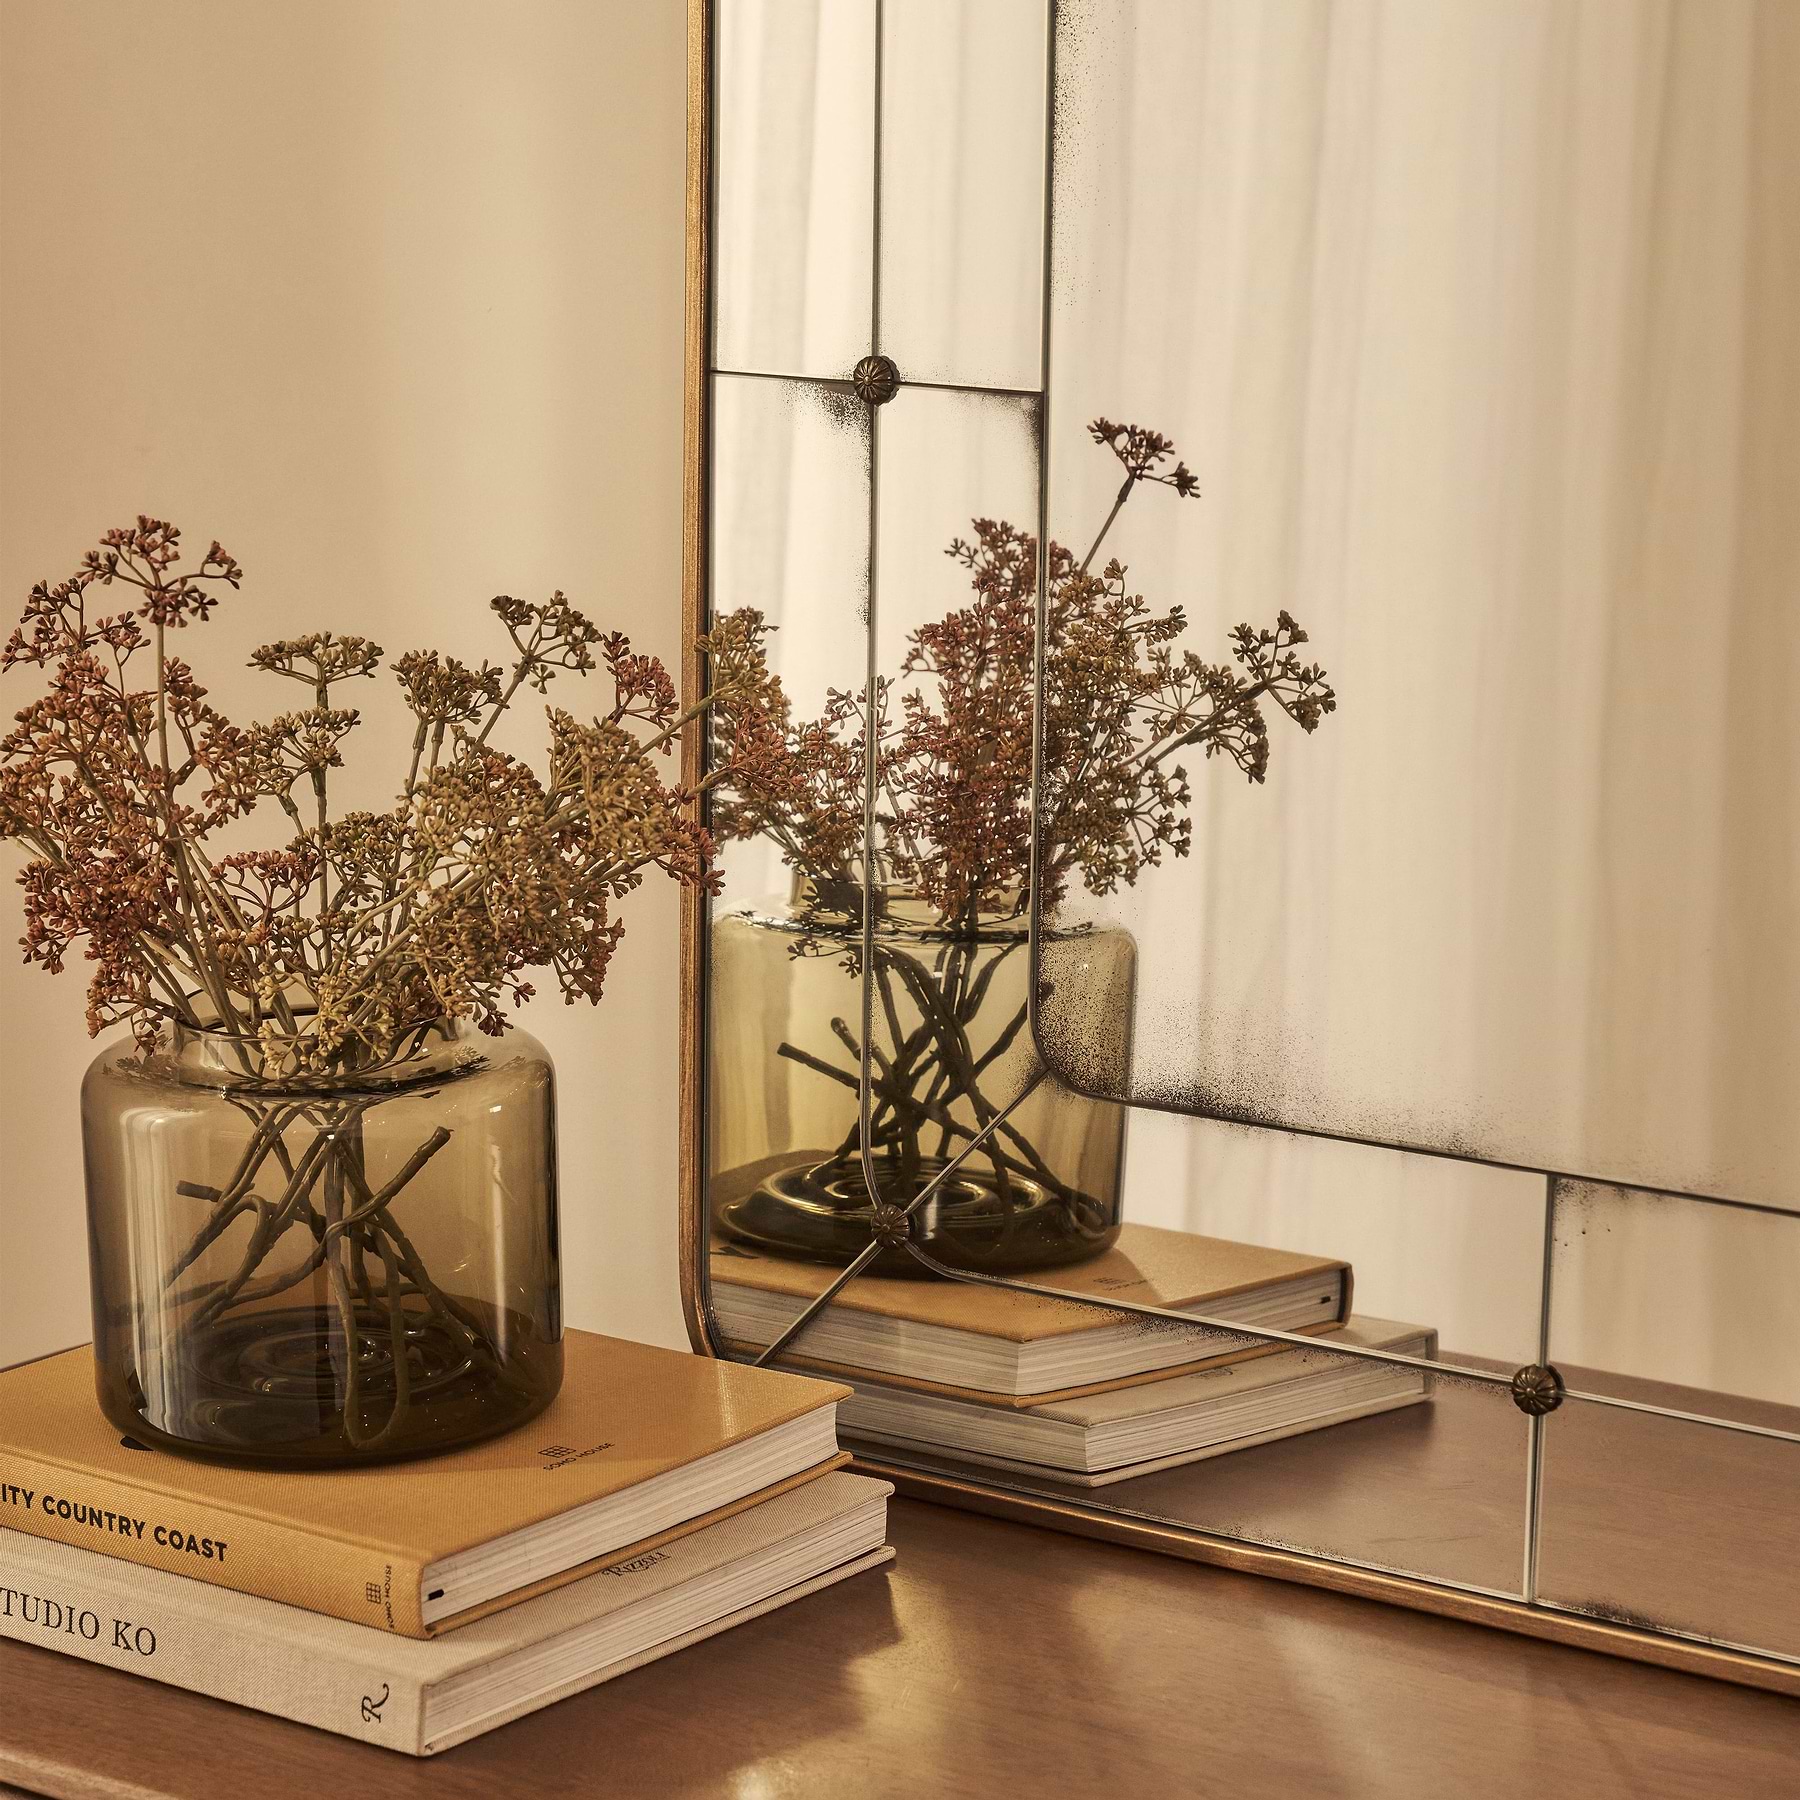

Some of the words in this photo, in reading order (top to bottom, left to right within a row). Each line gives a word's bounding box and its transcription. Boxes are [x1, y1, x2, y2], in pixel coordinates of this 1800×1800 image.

[42, 1495, 146, 1539] COUNTRY
[153, 1525, 228, 1562] COAST
[384, 1564, 392, 1598] HOUSE
[0, 1587, 100, 1641] TUDIO
[111, 1619, 157, 1656] KO
